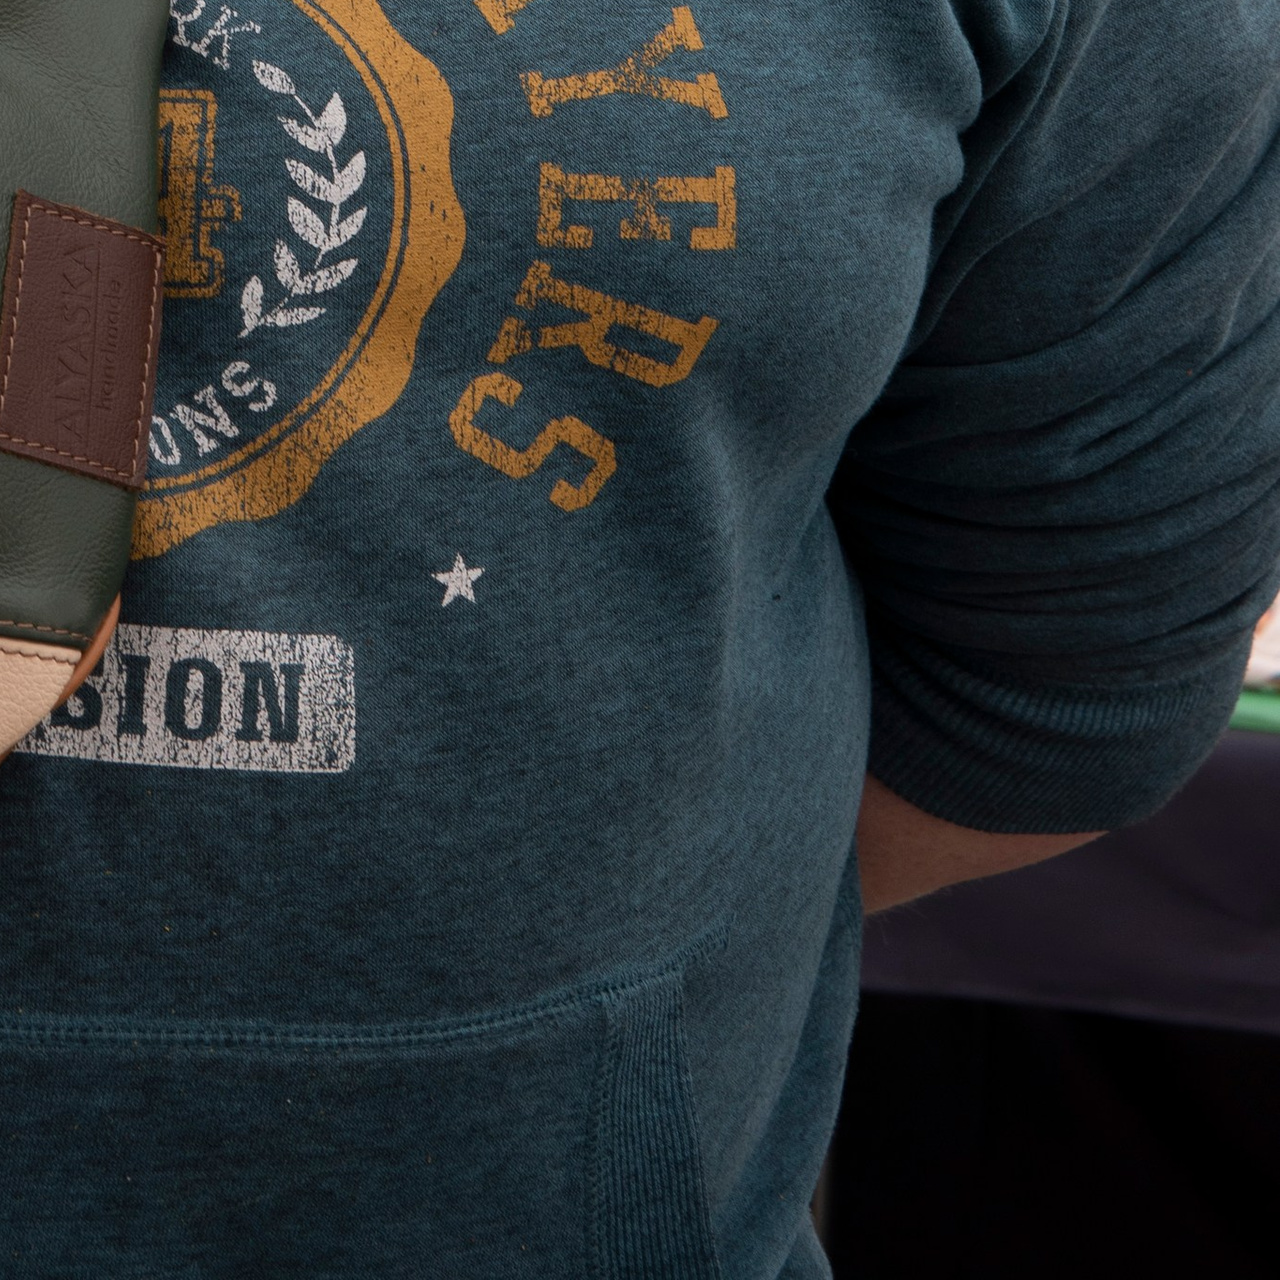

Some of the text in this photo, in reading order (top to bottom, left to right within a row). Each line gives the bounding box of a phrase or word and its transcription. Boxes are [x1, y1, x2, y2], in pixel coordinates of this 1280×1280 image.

[94, 277, 123, 412] handmade
[148, 360, 279, 466] ONS
[38, 651, 306, 745] SION
